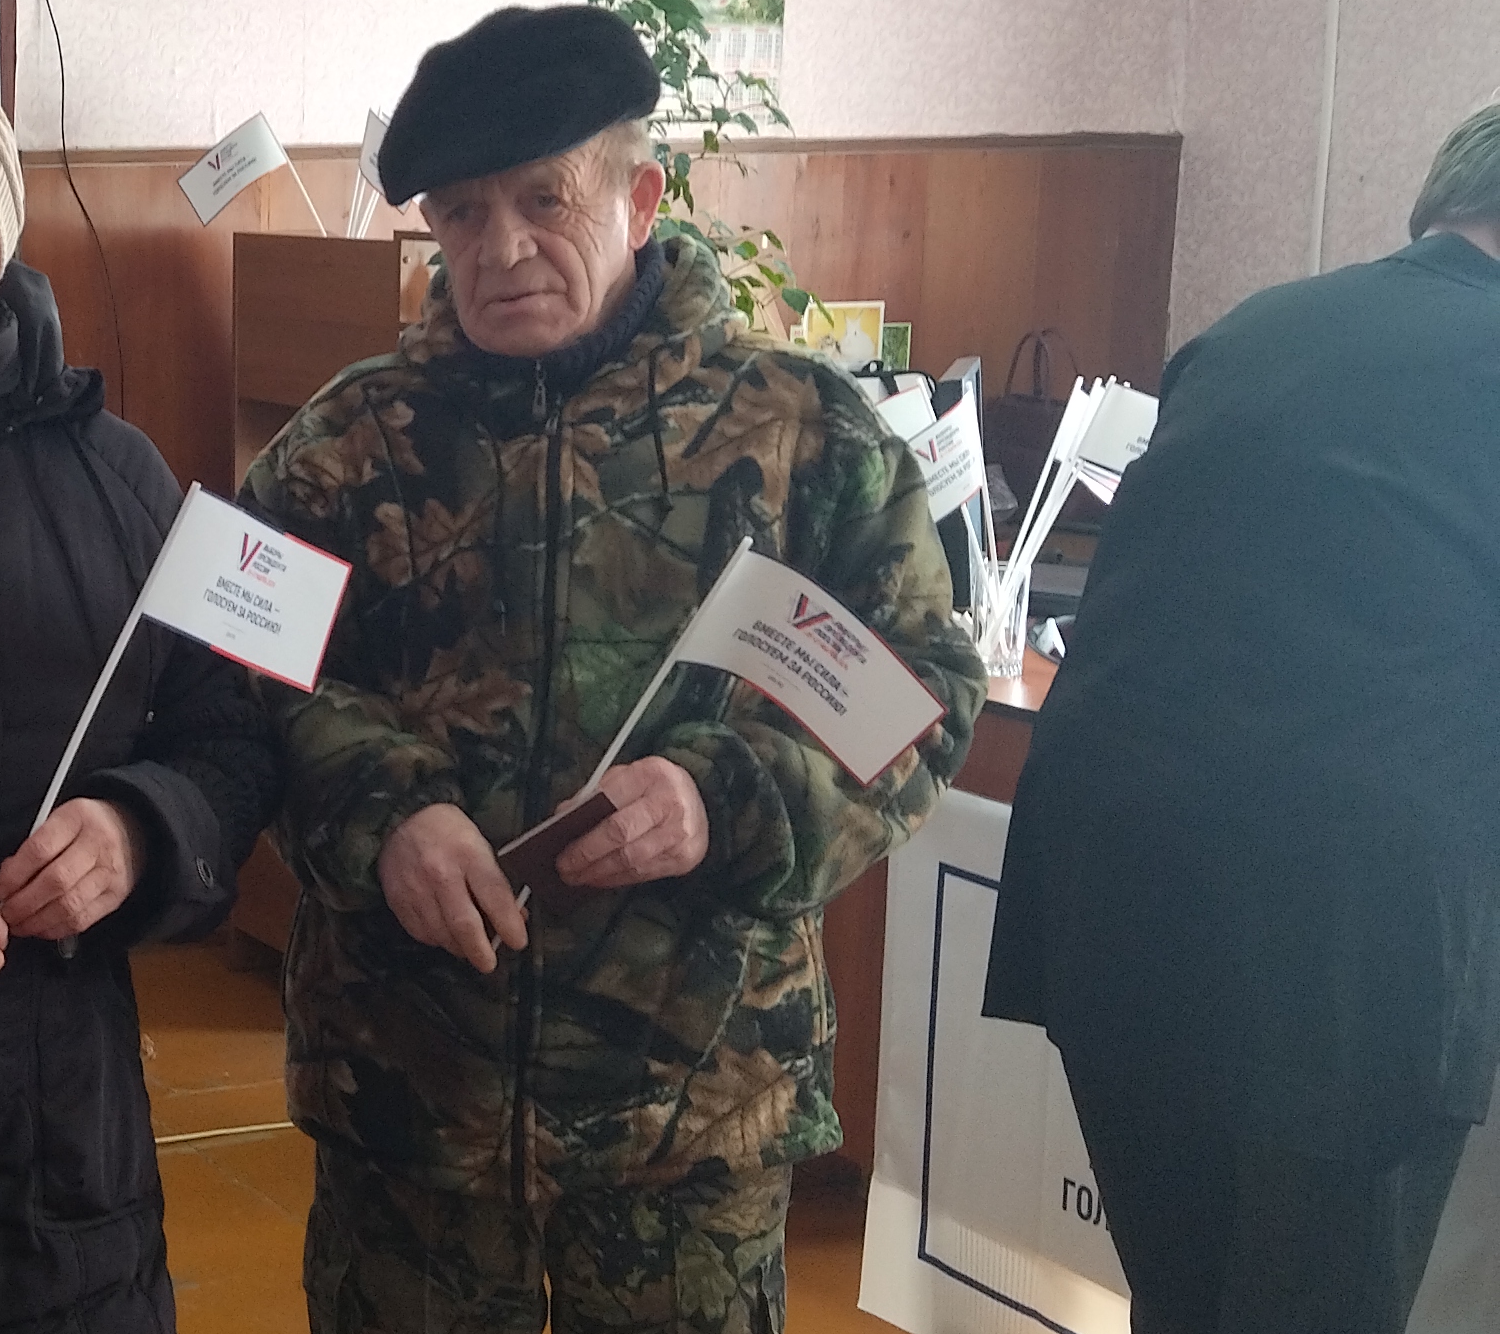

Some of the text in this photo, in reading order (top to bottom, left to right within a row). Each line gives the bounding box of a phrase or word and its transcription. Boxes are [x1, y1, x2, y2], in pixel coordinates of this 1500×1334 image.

[203, 588, 238, 614] ГОЛОСУЕМ
[236, 605, 247, 619] ЗА
[216, 575, 242, 598] ВМЕСТЕ
[241, 587, 255, 604] МЫ
[253, 594, 273, 613] СИЛА
[752, 619, 797, 650] ВМЕСТЕ
[814, 661, 842, 692] СИЛА
[787, 659, 803, 675] ЗА
